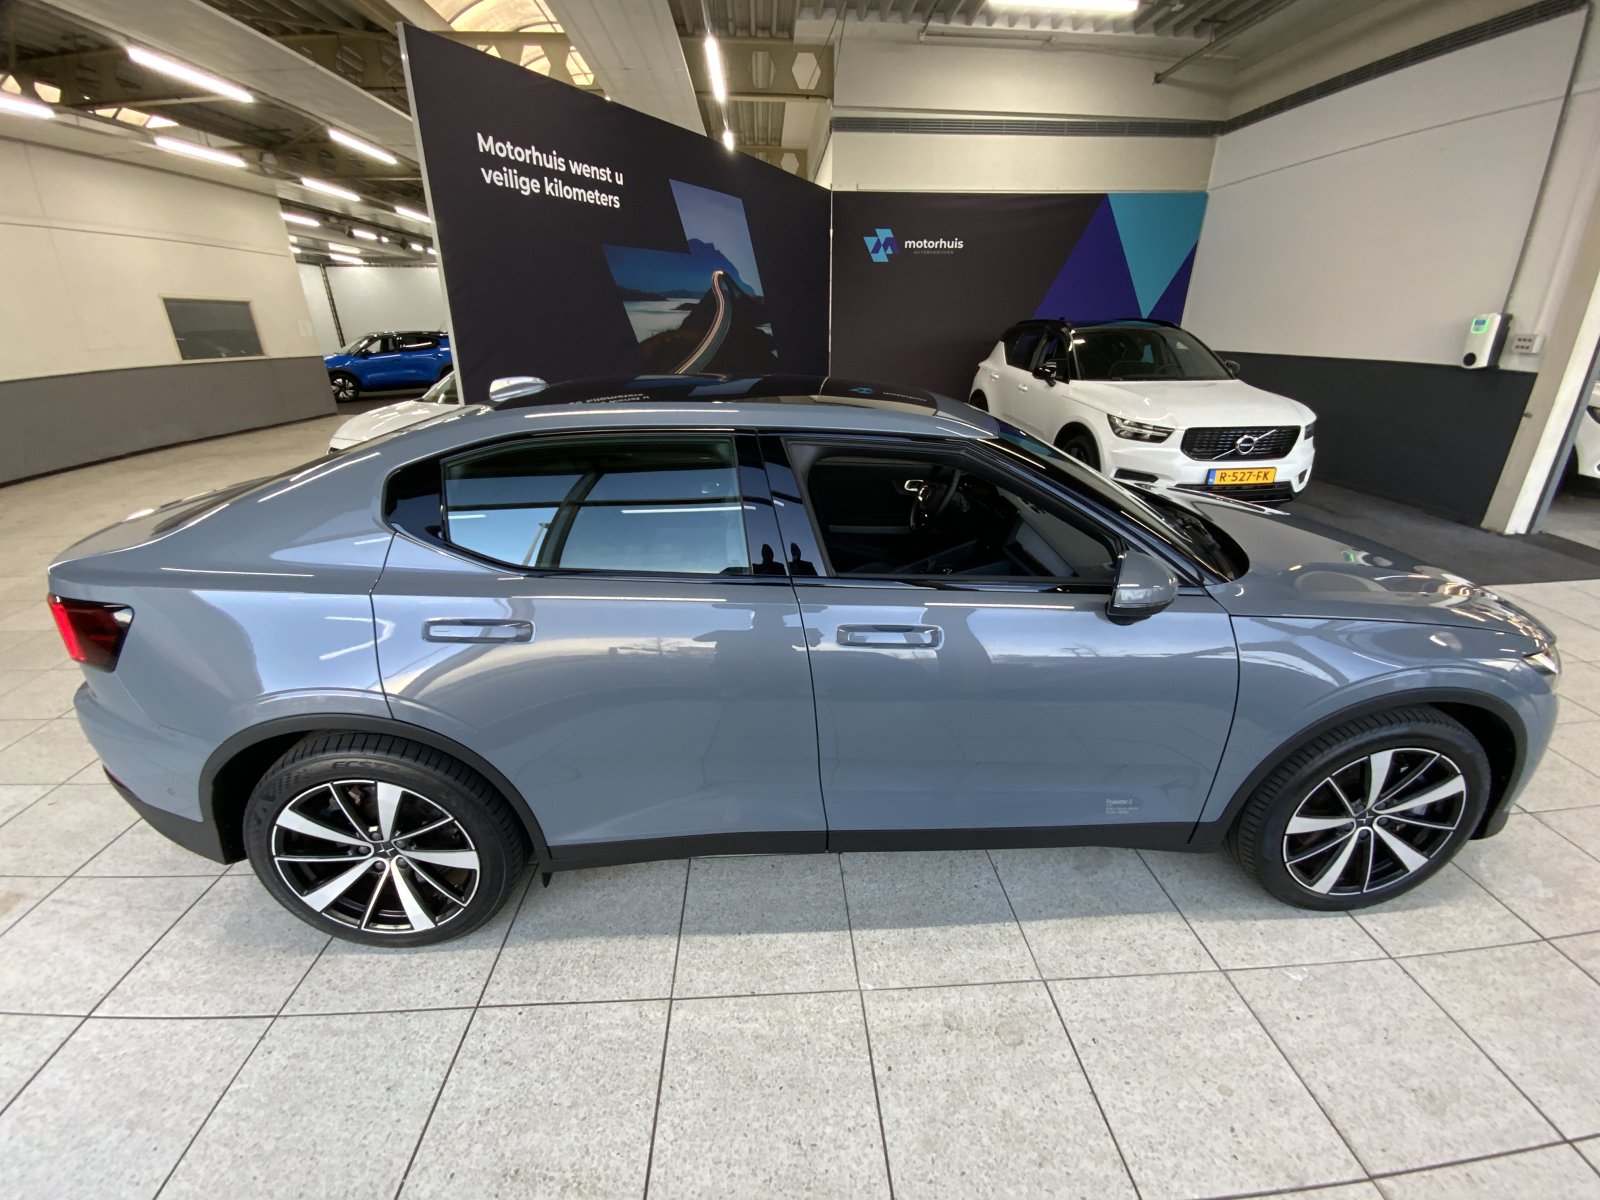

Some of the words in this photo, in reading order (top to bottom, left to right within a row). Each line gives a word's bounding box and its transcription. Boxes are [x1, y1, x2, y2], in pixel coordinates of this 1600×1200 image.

[476, 132, 566, 172] Motorhuis
[568, 159, 613, 183] wenst
[614, 171, 624, 186] u
[480, 166, 541, 196] veilige
[543, 176, 621, 209] kilometers
[904, 237, 964, 249] motorhuis
[1219, 470, 1271, 482] R-527-FK
